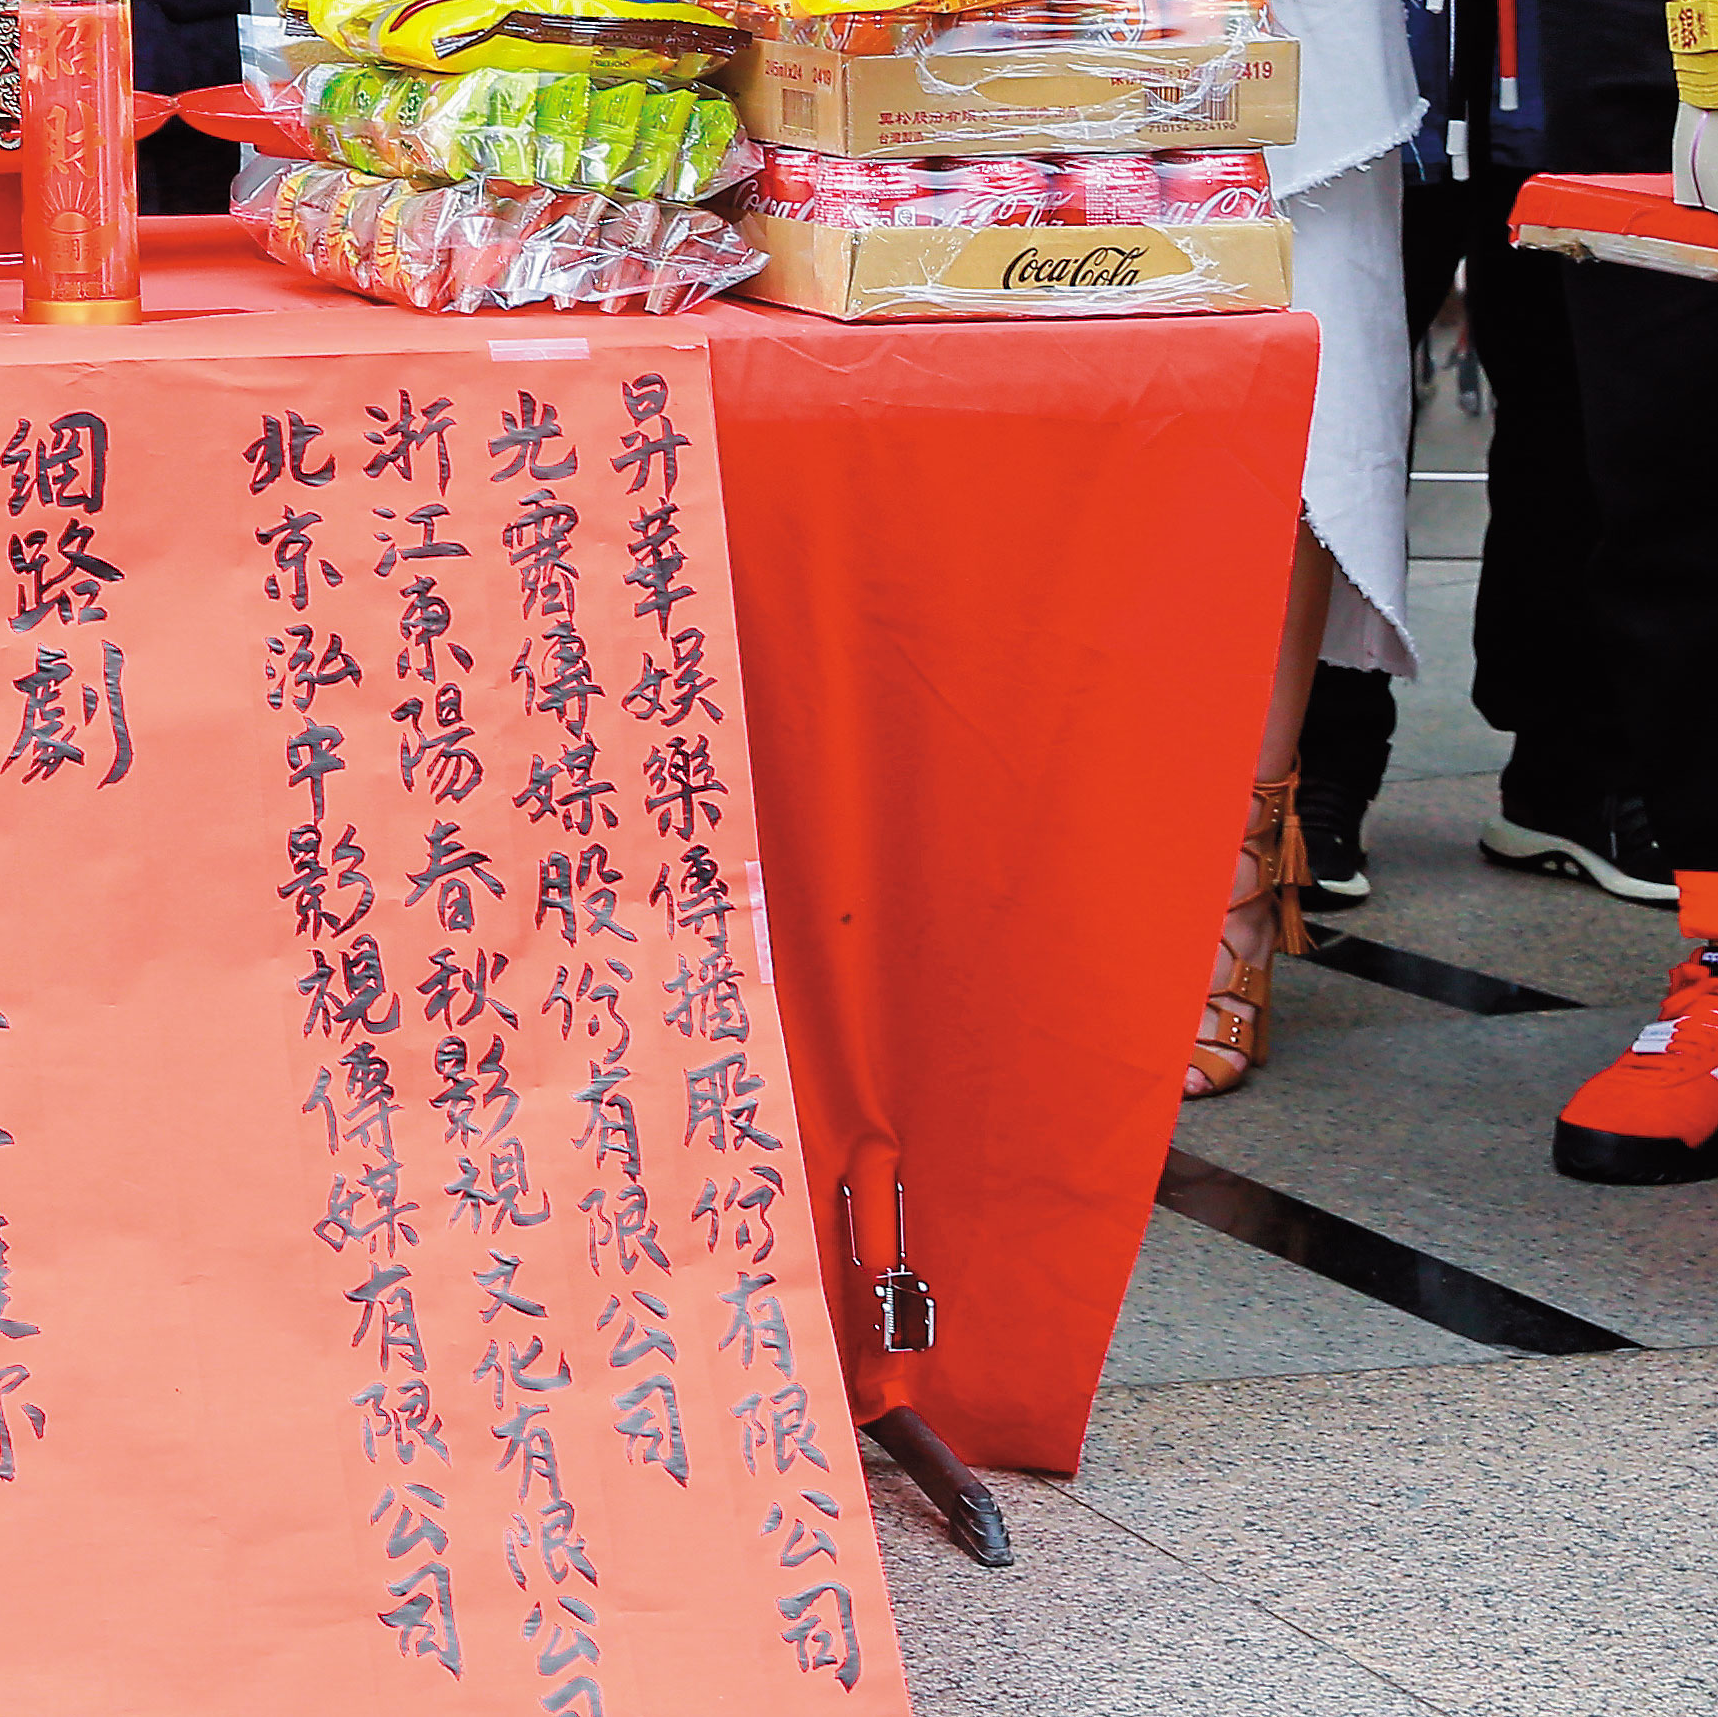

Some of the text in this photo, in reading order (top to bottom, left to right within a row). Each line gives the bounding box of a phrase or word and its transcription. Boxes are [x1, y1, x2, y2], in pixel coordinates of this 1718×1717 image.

[34, 13, 106, 178] 招財
[1000, 245, 1150, 290] Coca-Cola
[0, 412, 133, 790] 網路劇
[612, 373, 861, 1693] 昇華娛樂傳播股份有限公司
